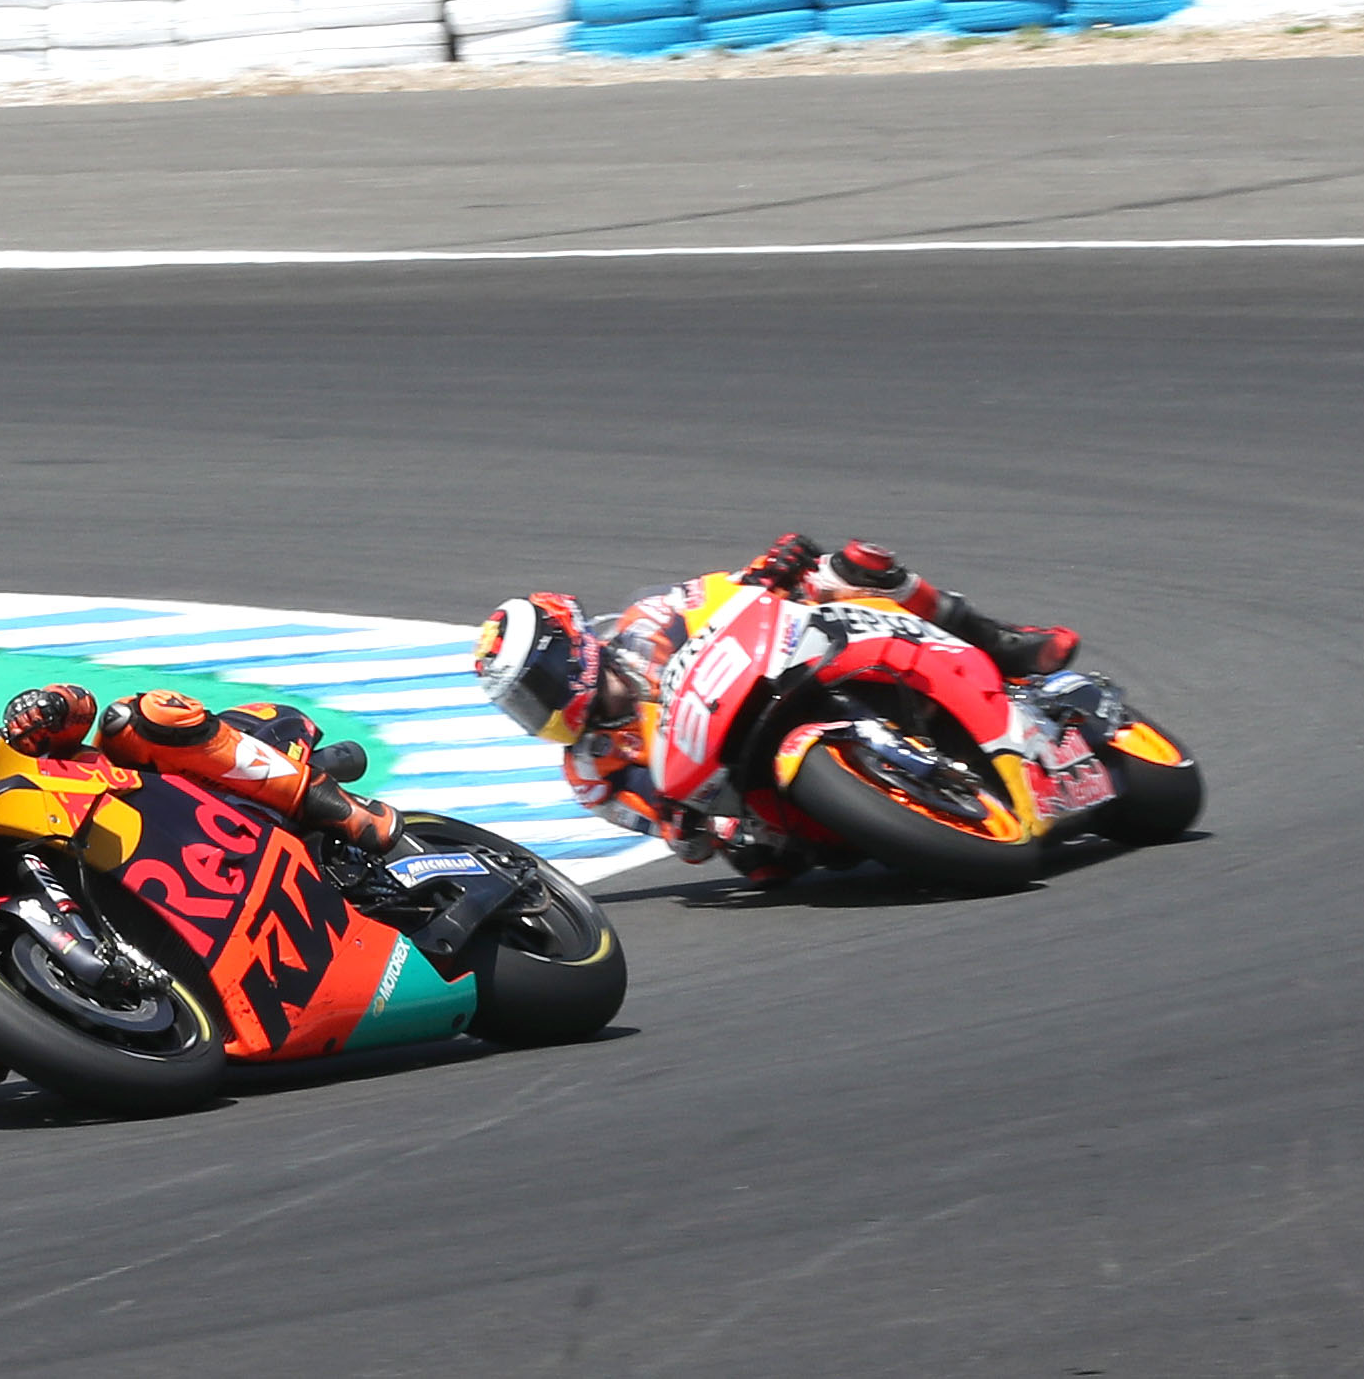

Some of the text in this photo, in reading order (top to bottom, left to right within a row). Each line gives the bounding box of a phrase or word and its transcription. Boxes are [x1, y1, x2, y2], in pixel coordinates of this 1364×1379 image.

[121, 774, 262, 958] Red
[406, 857, 477, 875] MICHELIN
[239, 846, 349, 1053] KTM
[379, 936, 411, 1002] MOTOREX
